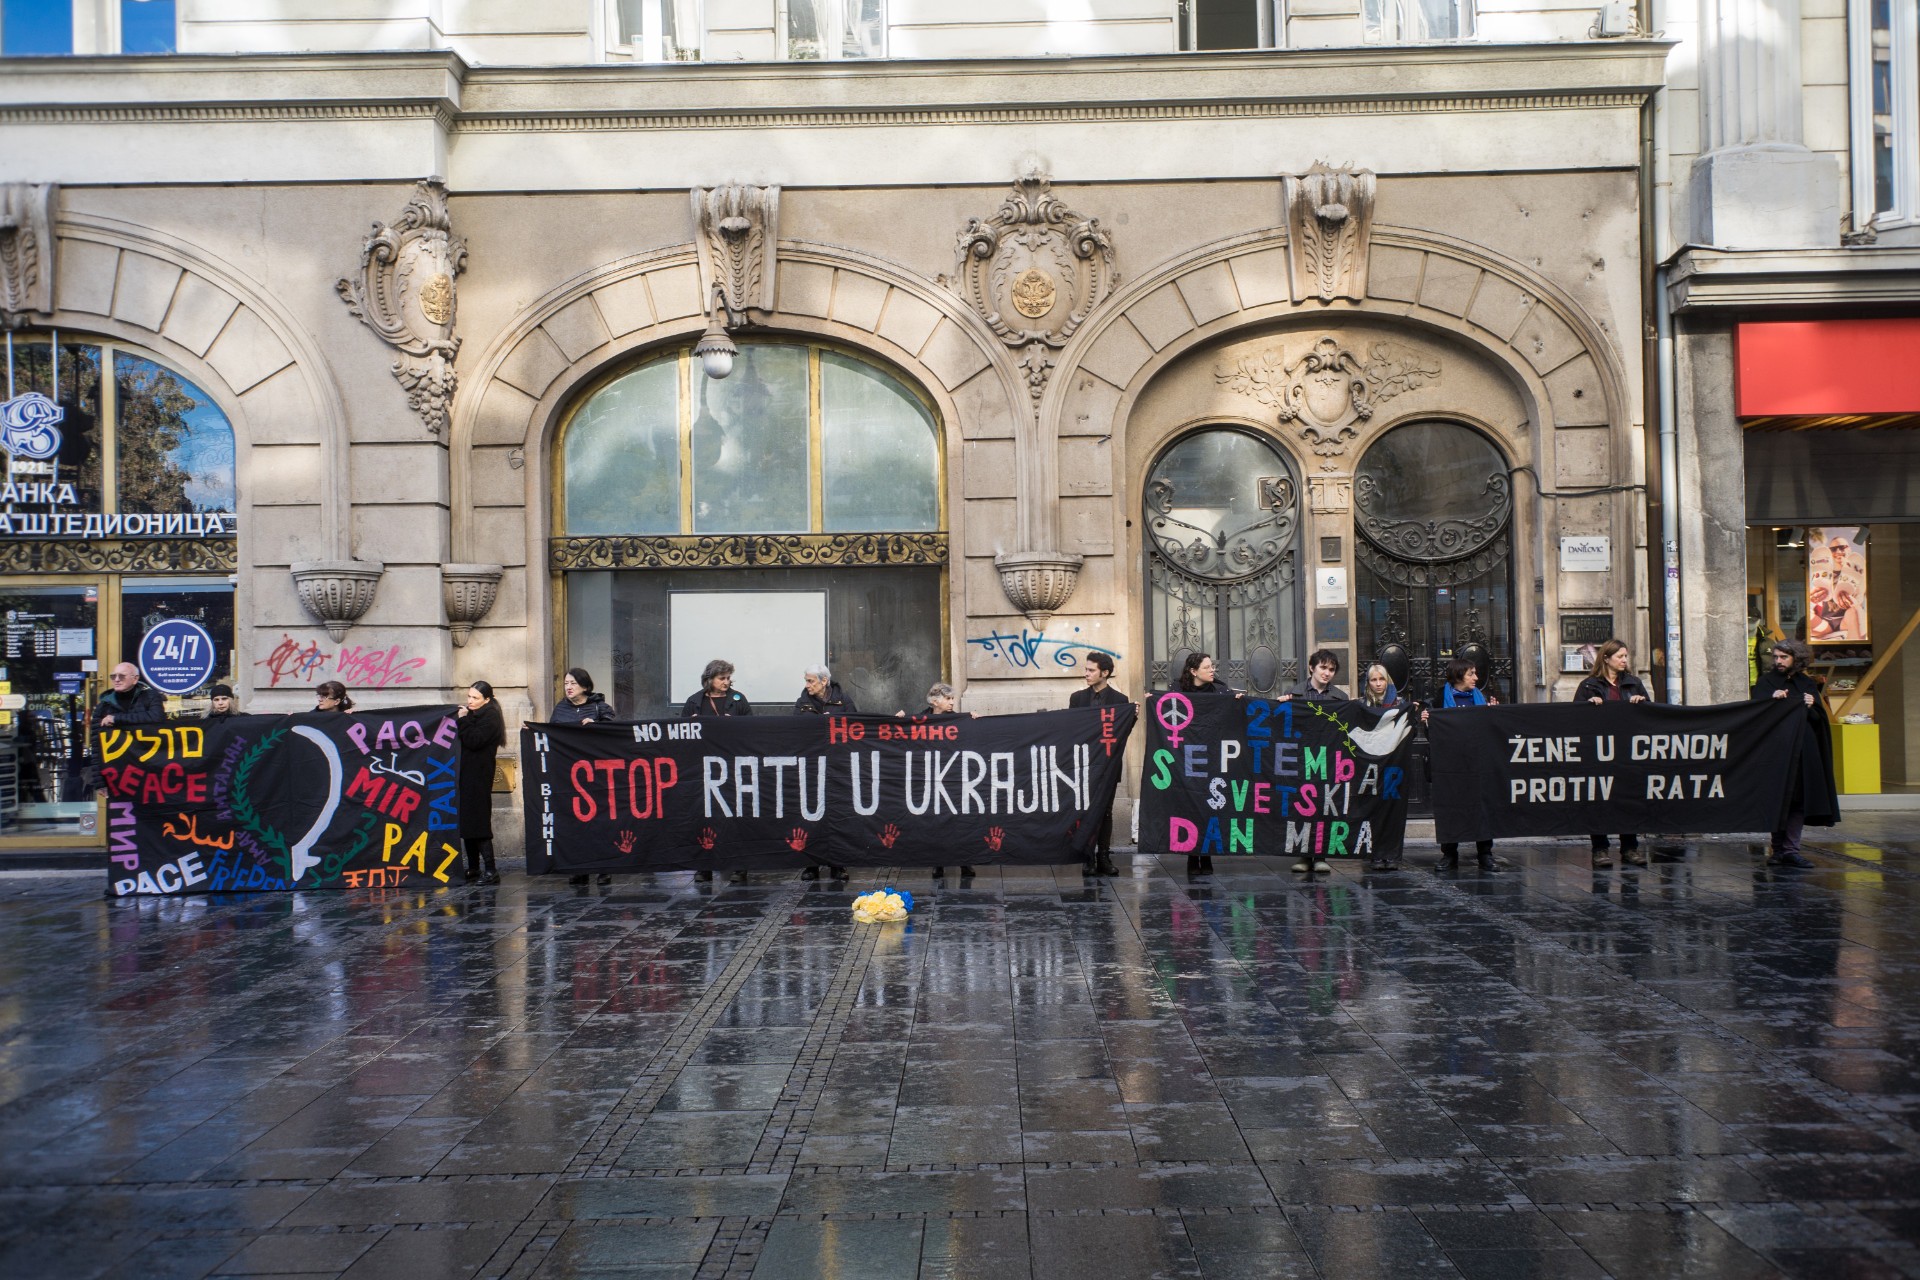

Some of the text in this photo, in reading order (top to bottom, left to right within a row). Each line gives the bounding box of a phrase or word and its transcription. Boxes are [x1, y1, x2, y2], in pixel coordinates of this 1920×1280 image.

[0, 482, 78, 504] АНКА
[21, 513, 225, 538] ШТЕДИОНИЦА
[153, 634, 200, 664] 24/7
[346, 716, 458, 755] PAQE
[633, 722, 702, 742] NO WAR
[829, 717, 866, 744] Не
[1101, 708, 1117, 757] НЕТ
[1246, 700, 1302, 738] 21.
[1508, 733, 1729, 762] ŽENE U CRNOM
[101, 763, 207, 804] PEACE
[345, 766, 421, 824] MIR
[426, 756, 458, 831] PAIX
[571, 743, 1089, 822] STOP RATU U UKRAJINI
[1207, 777, 1350, 817] SVETSKI
[1511, 774, 1725, 803] PROTIV RATA
[382, 823, 459, 883] PAZ
[1169, 817, 1373, 855] DAN MIRA
[115, 851, 208, 896] PACE
